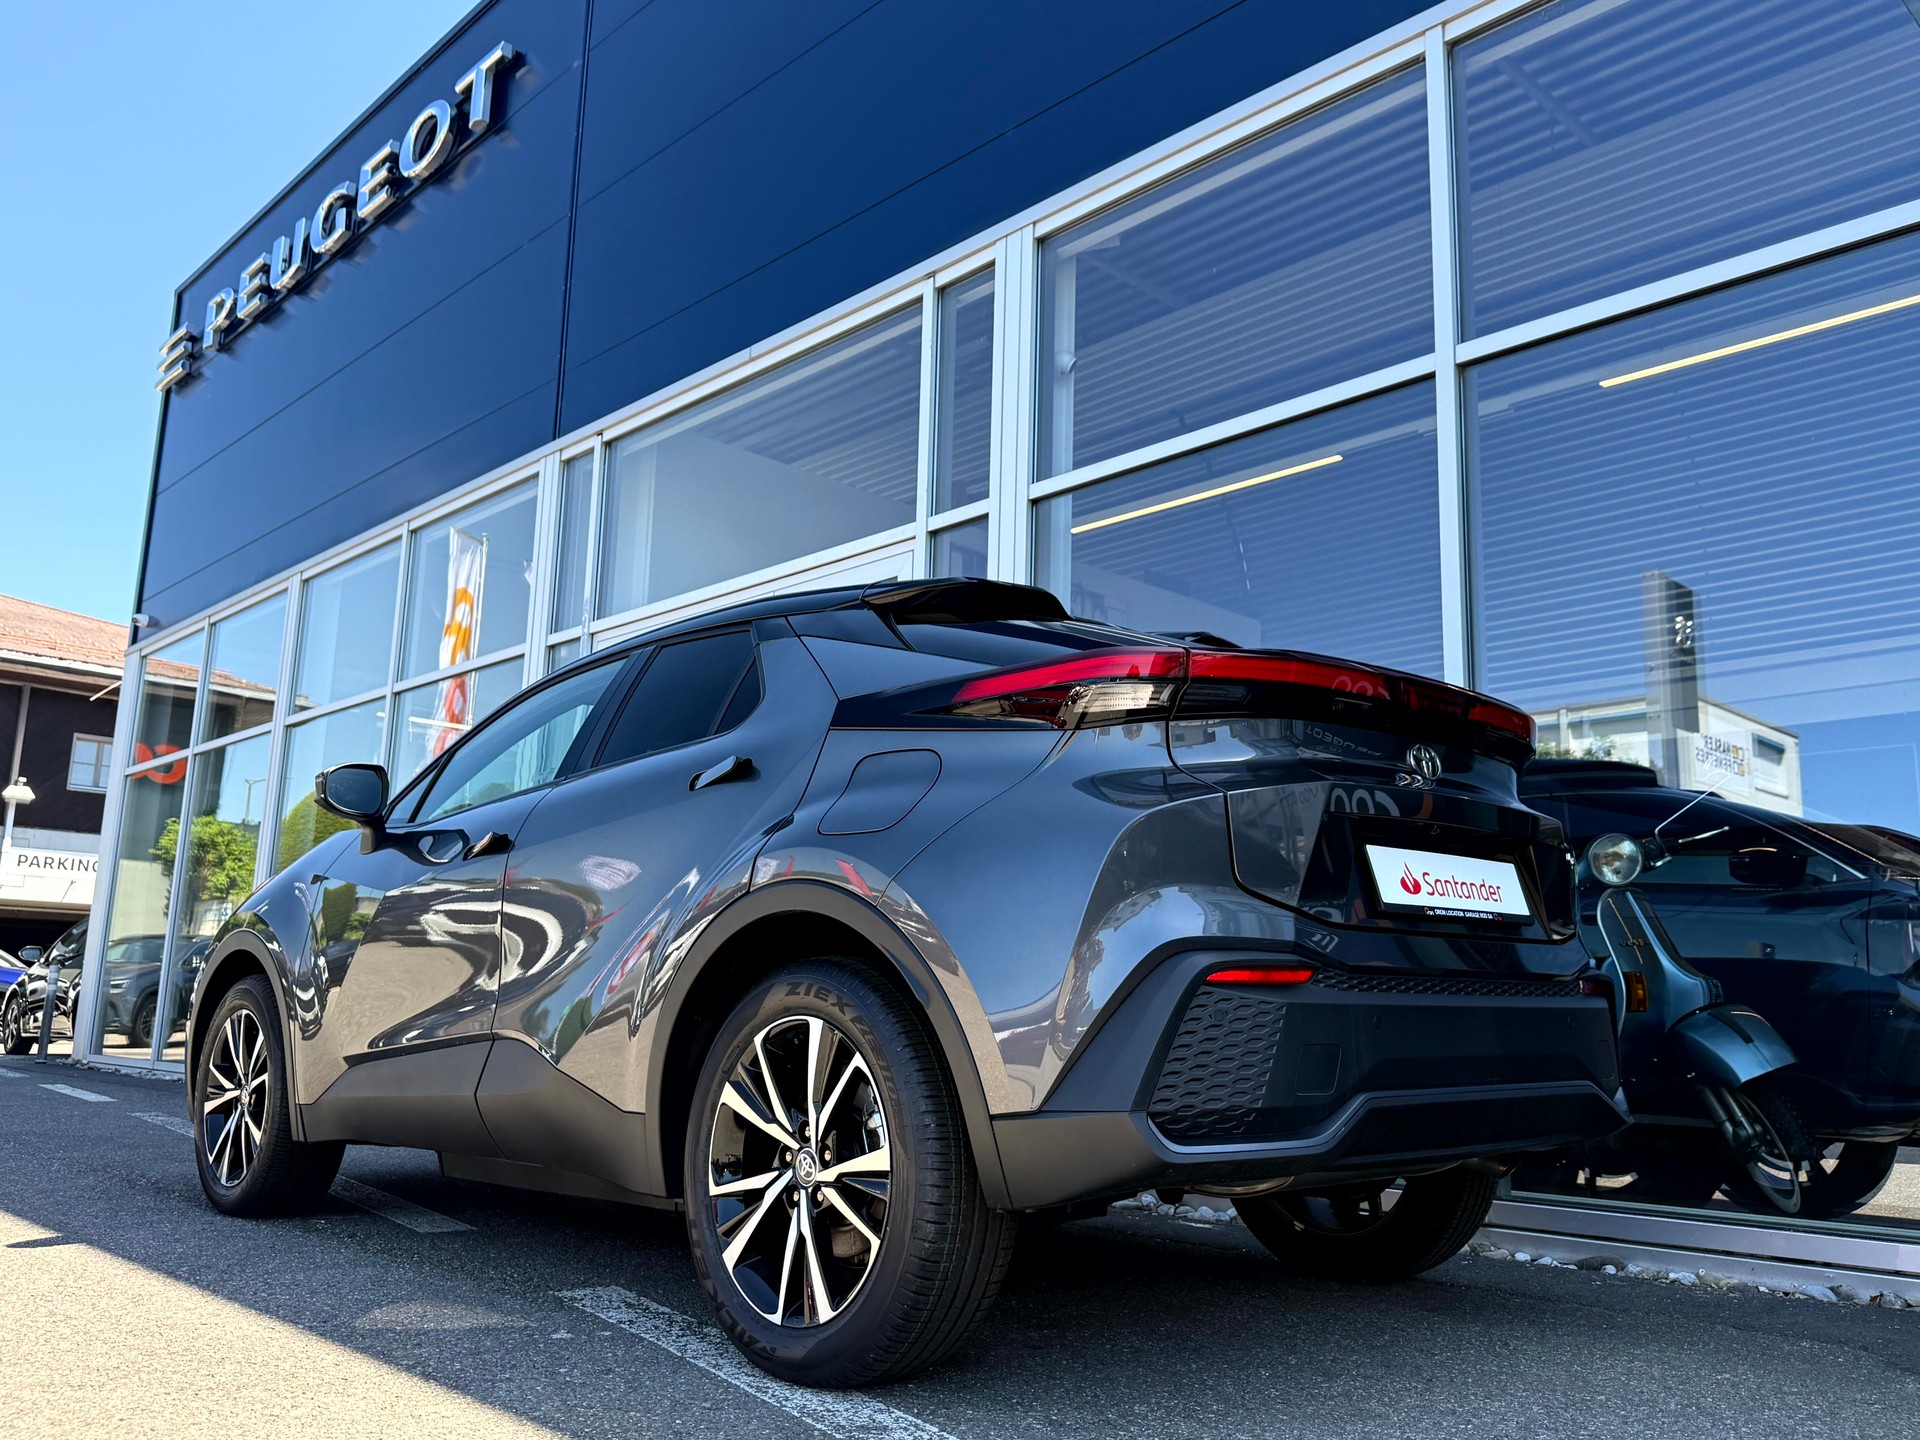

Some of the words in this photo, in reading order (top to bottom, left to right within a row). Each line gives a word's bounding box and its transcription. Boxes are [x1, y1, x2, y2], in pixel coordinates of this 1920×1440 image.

[203, 40, 516, 351] PEUGEOT
[1422, 871, 1503, 902] Santander
[785, 982, 855, 1015] ZIEX
[690, 1217, 777, 1361] FALKEN
